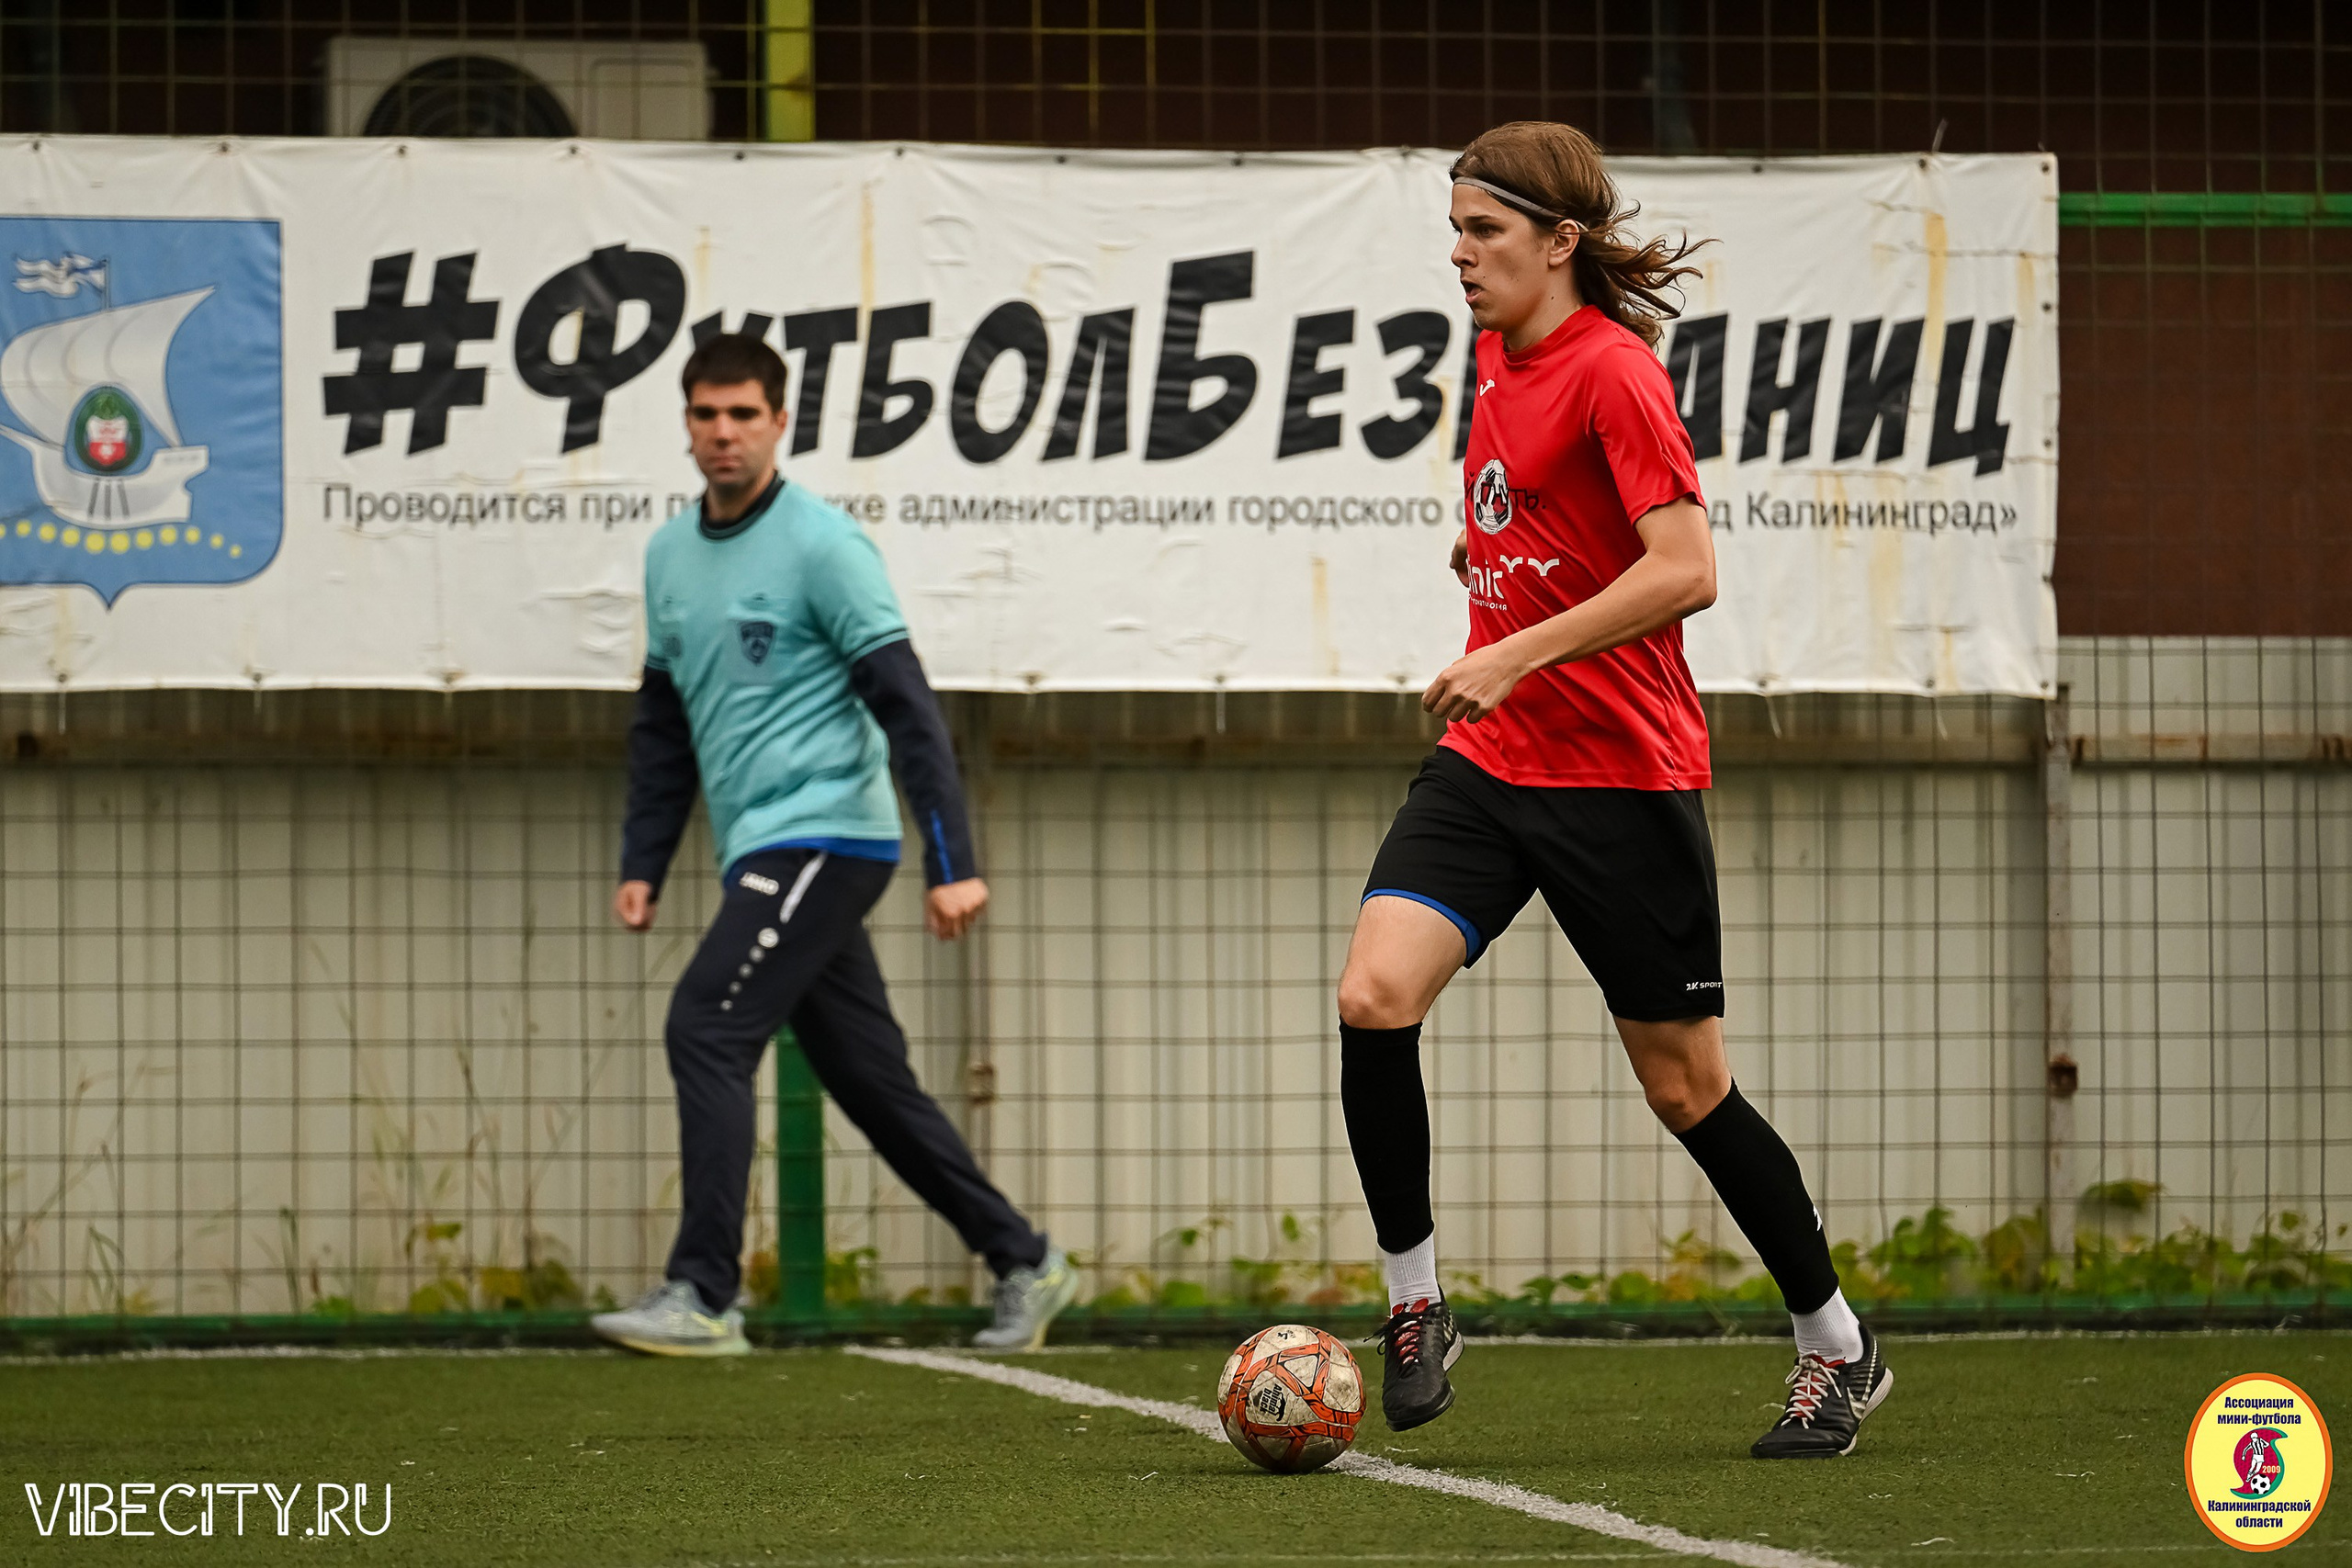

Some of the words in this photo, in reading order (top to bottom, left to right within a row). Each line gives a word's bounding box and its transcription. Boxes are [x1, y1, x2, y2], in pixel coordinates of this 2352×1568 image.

[323, 482, 567, 530] Проводится
[580, 491, 653, 530] при
[899, 493, 1215, 532] администрации
[1228, 495, 1443, 533] городского
[1747, 491, 2018, 536] Калининград»
[1700, 981, 1723, 989] SPORT
[1260, 1387, 1272, 1412] black
[1268, 1383, 1283, 1415] Animal
